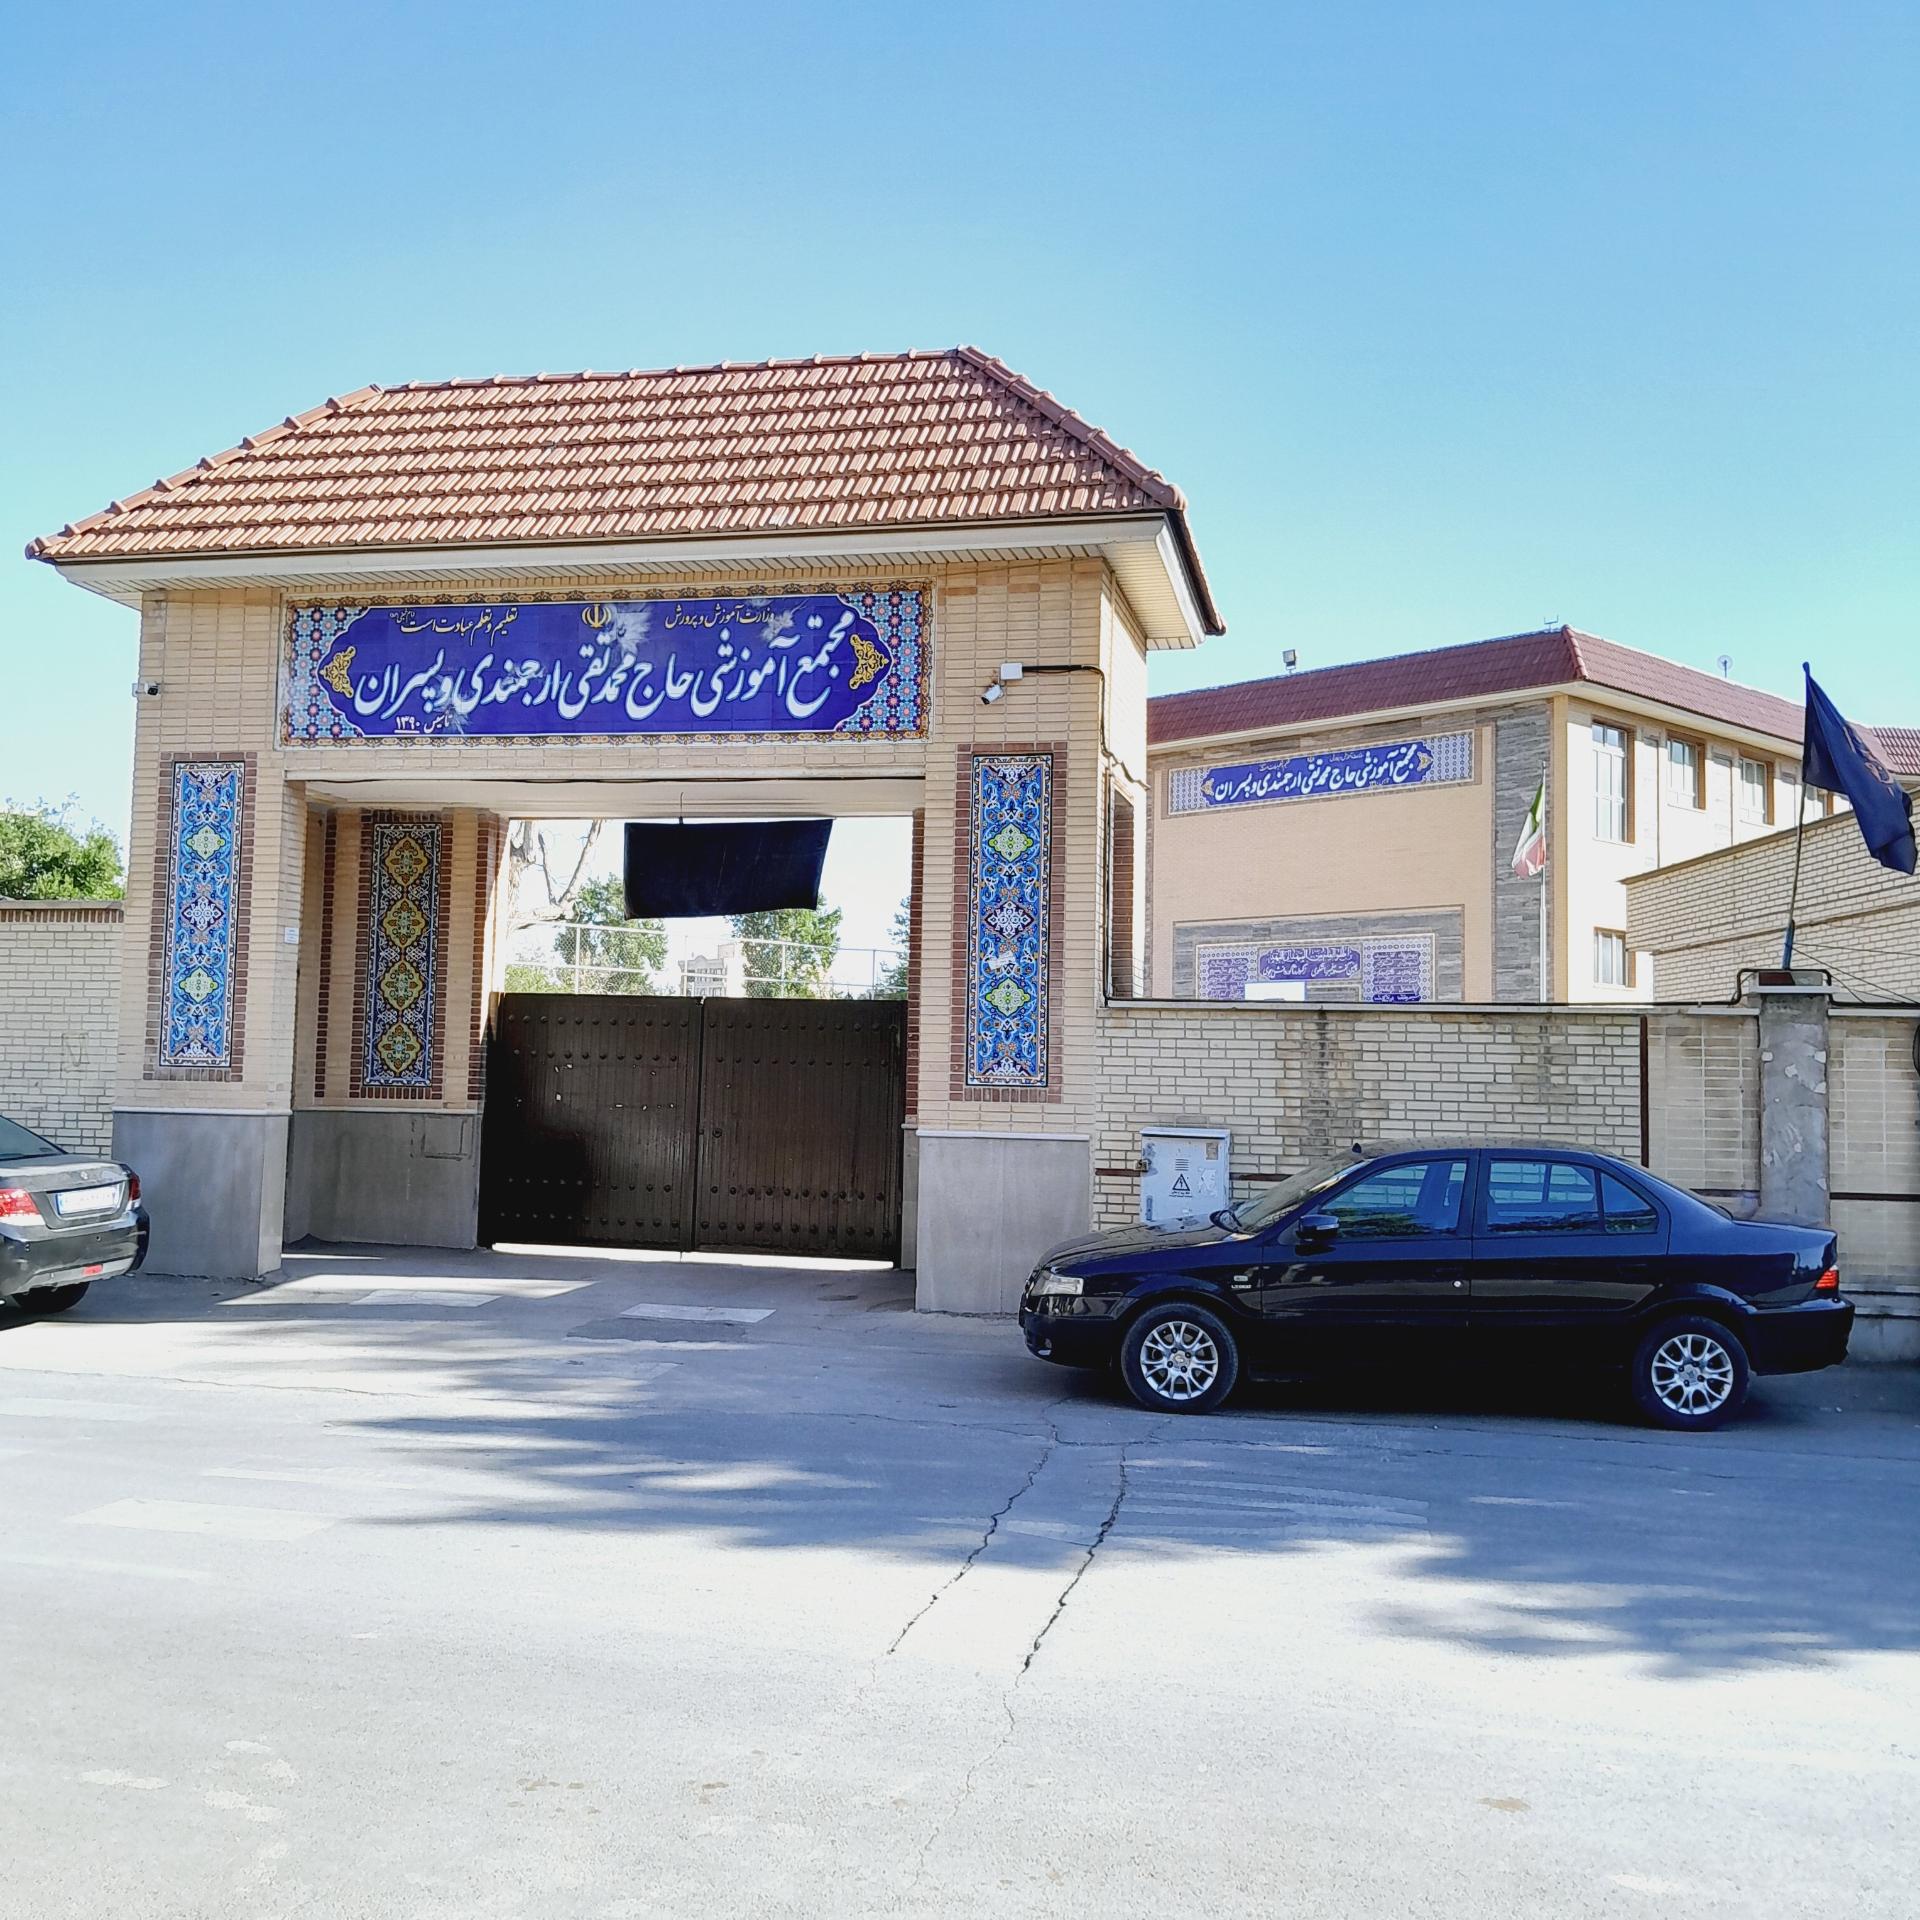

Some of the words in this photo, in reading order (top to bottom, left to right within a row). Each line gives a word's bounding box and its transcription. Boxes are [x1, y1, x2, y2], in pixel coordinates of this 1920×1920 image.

[400, 618, 437, 633] است
[434, 617, 474, 636] عبادت
[469, 608, 493, 647] تعلم
[484, 622, 493, 634] و
[489, 607, 518, 647] تعلیم
[665, 604, 699, 629] پرورش
[704, 603, 744, 628] آموزش
[739, 606, 775, 625] وزارت
[690, 627, 801, 718] آموزشی
[786, 610, 855, 724] مجتمع
[354, 648, 446, 721] پسران
[432, 675, 453, 707] و
[452, 653, 562, 715] ارجمندی
[625, 652, 695, 721] حاج
[1328, 765, 1357, 791] حاج
[1354, 750, 1400, 788] آموزشی
[1393, 743, 1418, 783] مجتمع
[1214, 772, 1253, 801] پسران
[1256, 771, 1302, 797] ارجمندی
